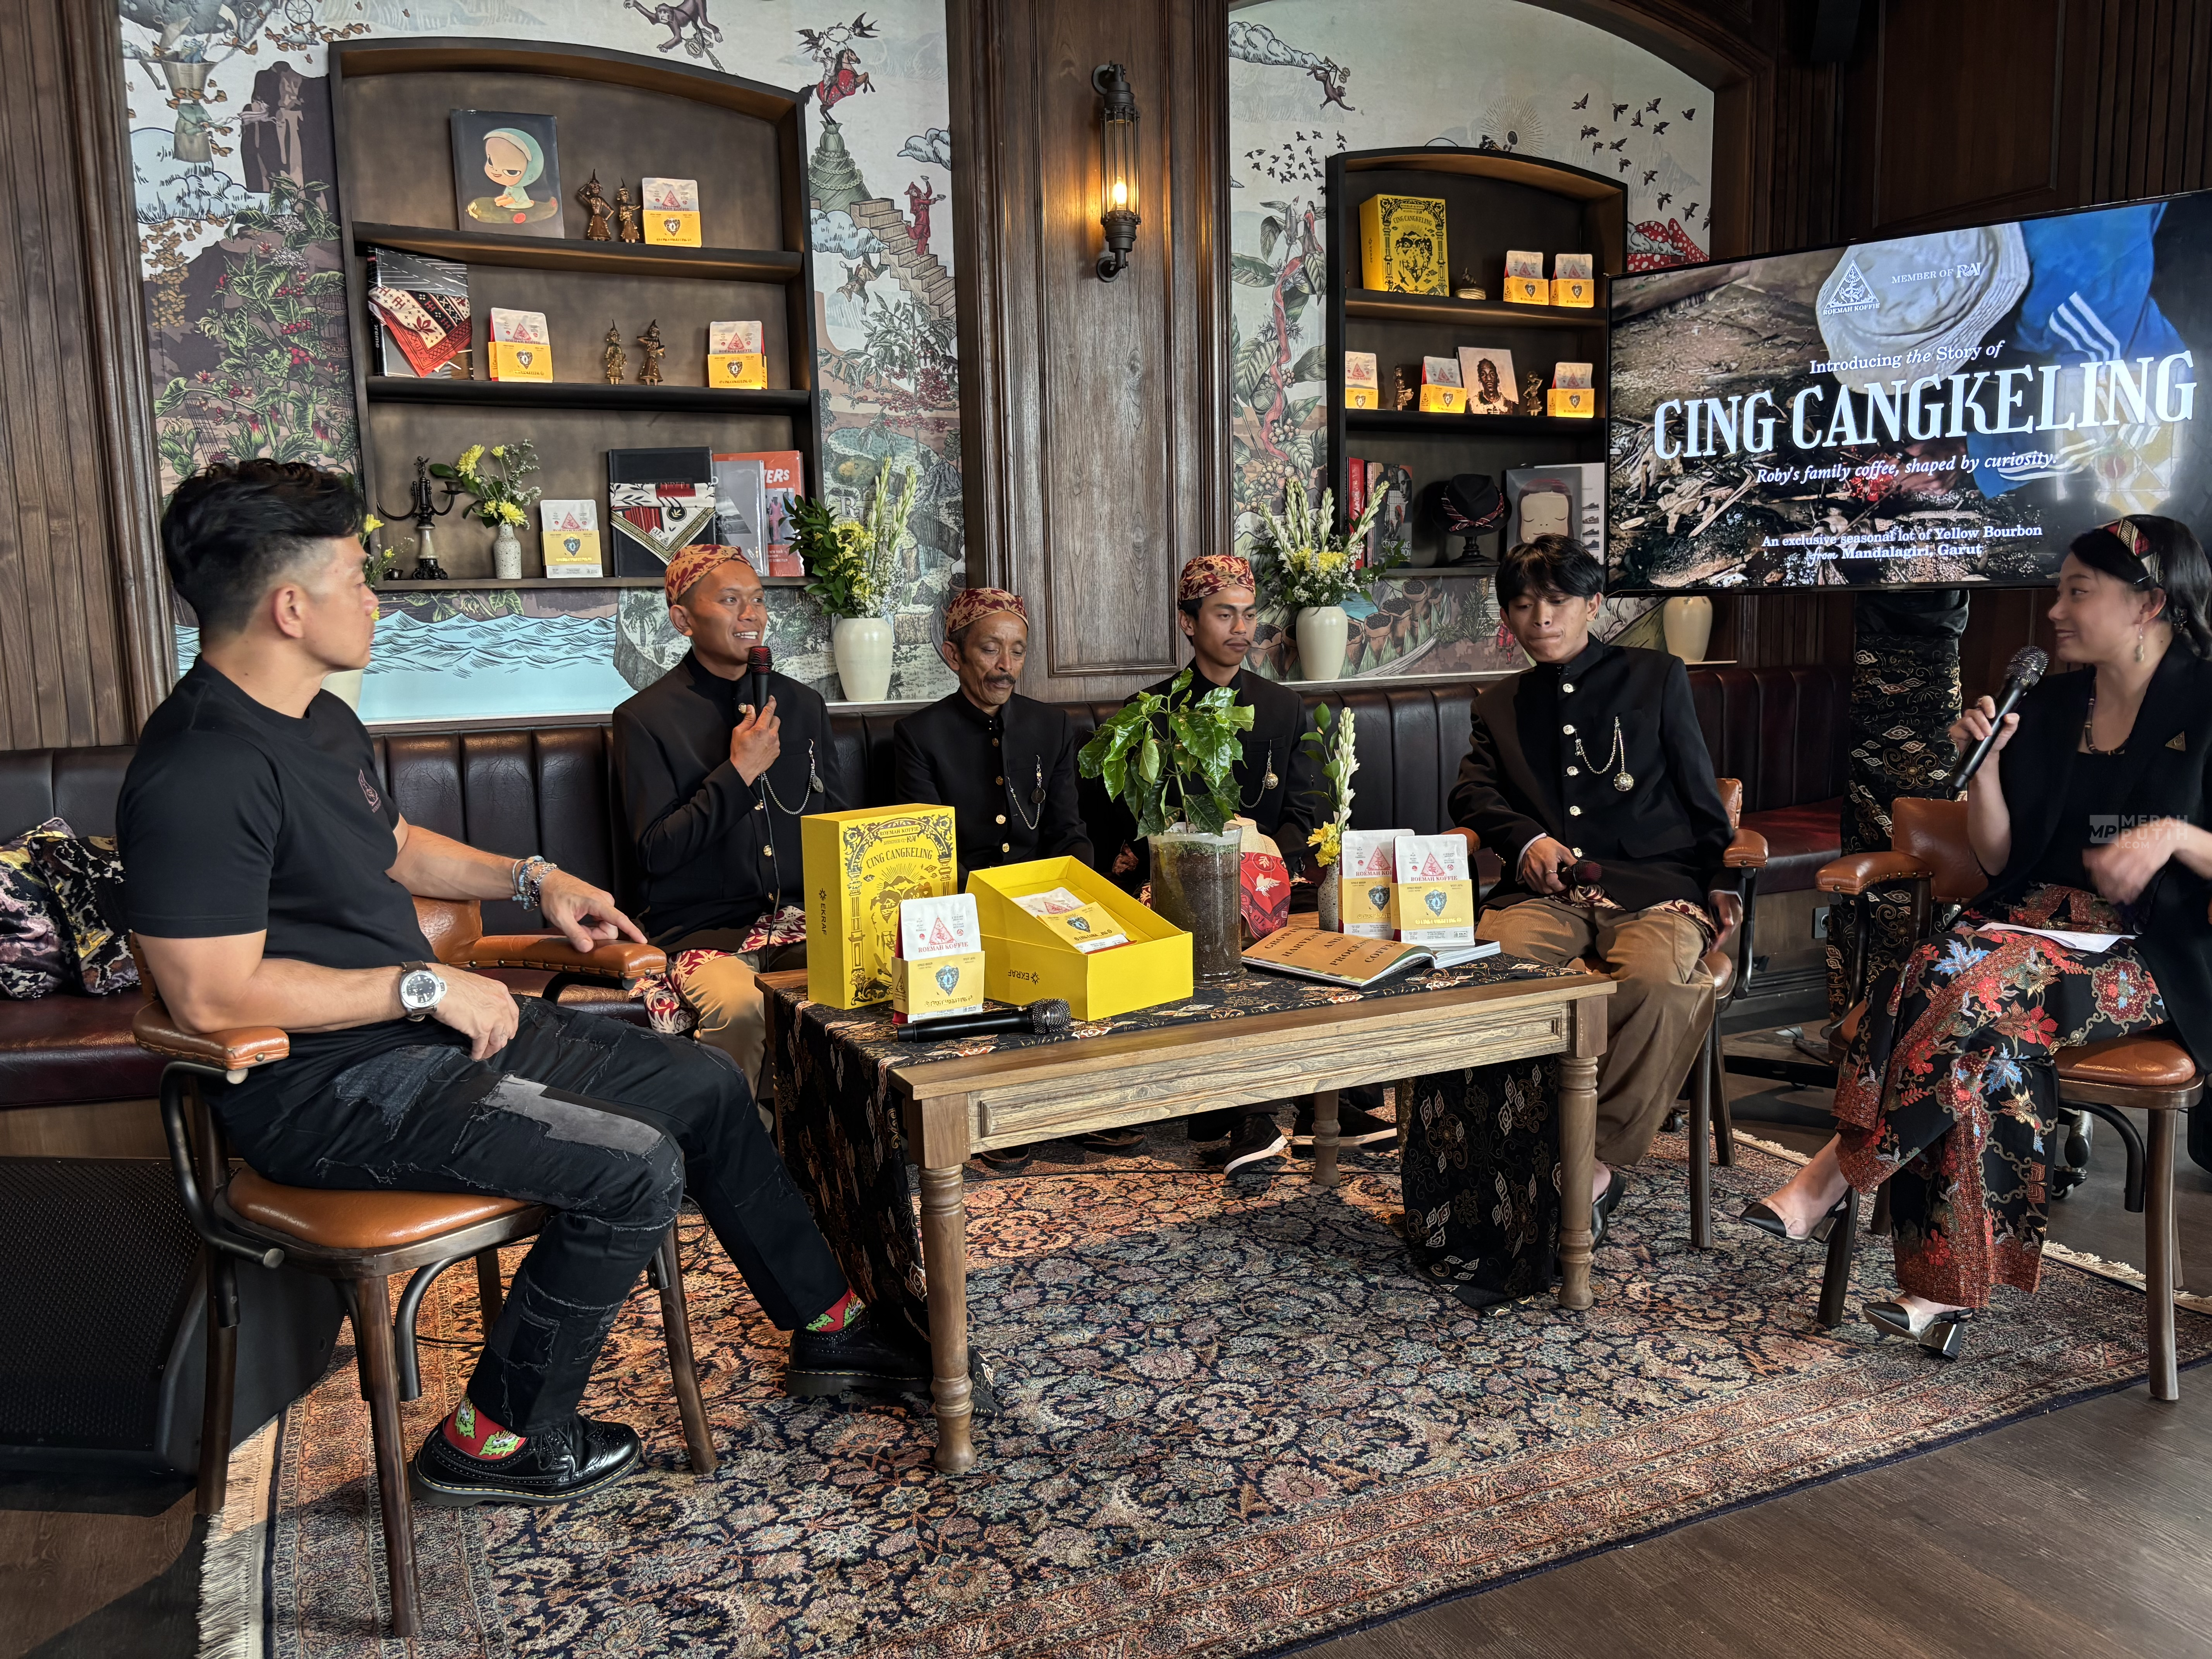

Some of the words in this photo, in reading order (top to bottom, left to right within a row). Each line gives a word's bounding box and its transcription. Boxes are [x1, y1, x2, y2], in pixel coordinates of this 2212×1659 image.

[1404, 215, 1432, 226] CANGKELING
[1892, 271, 1937, 284] MEMBER
[1939, 268, 1954, 278] OF
[1823, 305, 1853, 316] ROEMAH
[1854, 302, 1880, 312] KOFFIE
[1810, 354, 1902, 374] Introducing
[1906, 350, 1931, 364] the
[1936, 344, 1982, 361] Story
[1986, 340, 2005, 359] of
[1654, 390, 1776, 460] CING
[1792, 350, 2197, 449] CANGKELING
[1755, 466, 1800, 485] Roby's
[1801, 464, 1850, 484] family
[1855, 461, 1899, 480] coffee,
[1905, 455, 1955, 477] shaped
[1962, 452, 1979, 471] by
[1985, 450, 2057, 470] curiosity.
[1762, 536, 1779, 546] An
[1782, 534, 1837, 546] exclusive
[1841, 531, 1895, 543] seasonal
[1898, 530, 1915, 541] lot
[1918, 528, 1932, 540] of
[1934, 527, 1979, 540] Yellow
[1983, 524, 2042, 538] Bourbon
[1807, 546, 1838, 567] from
[1841, 545, 1934, 560] Mandalagiri,
[1937, 543, 1983, 556] Garut
[866, 853, 884, 869] CING
[886, 847, 933, 860] CANGKELING
[1324, 937, 1344, 948] AND
[1008, 969, 1029, 980] EKRAF
